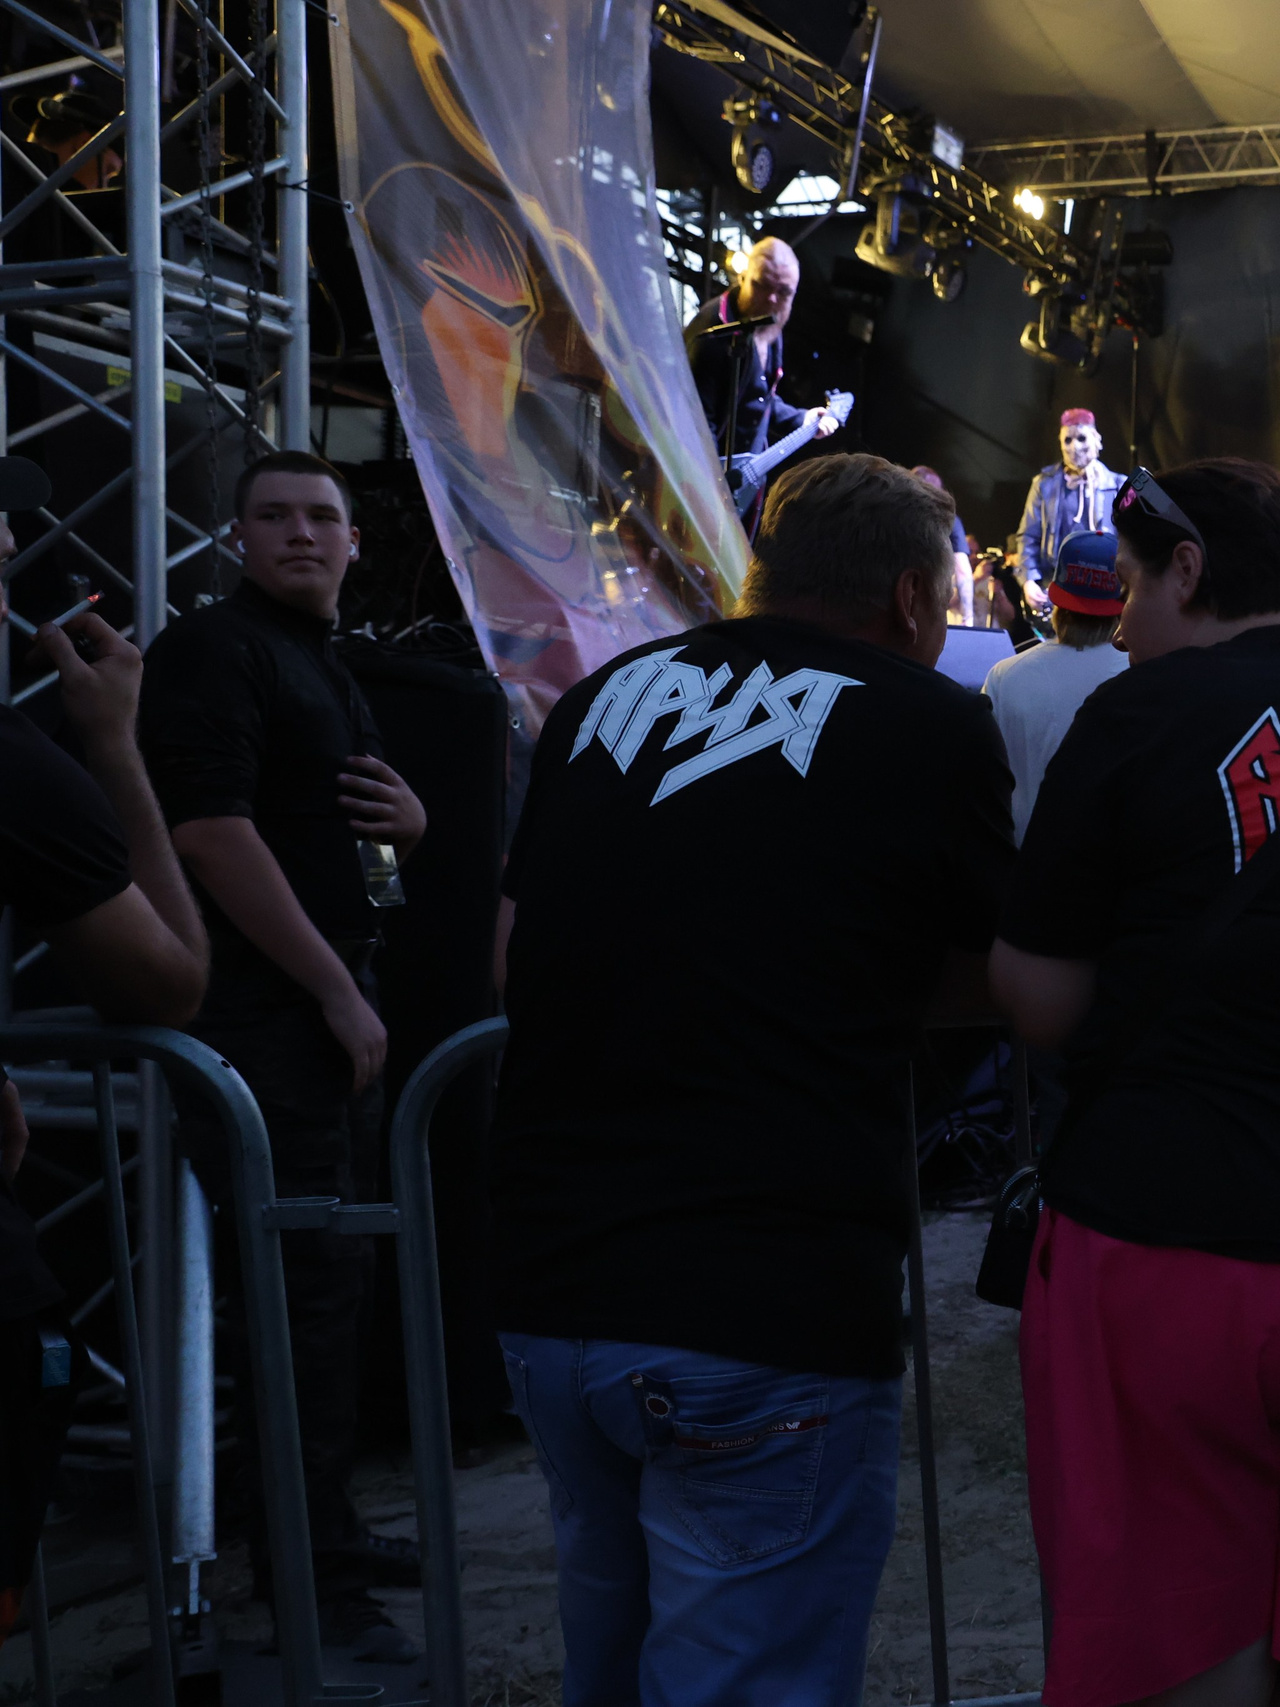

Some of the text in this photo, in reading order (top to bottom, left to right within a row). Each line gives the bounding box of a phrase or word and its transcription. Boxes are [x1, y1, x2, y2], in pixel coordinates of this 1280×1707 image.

[1065, 563, 1117, 592] FLYERS
[568, 643, 865, 808] АРИЯ
[711, 1436, 755, 1449] FASHION
